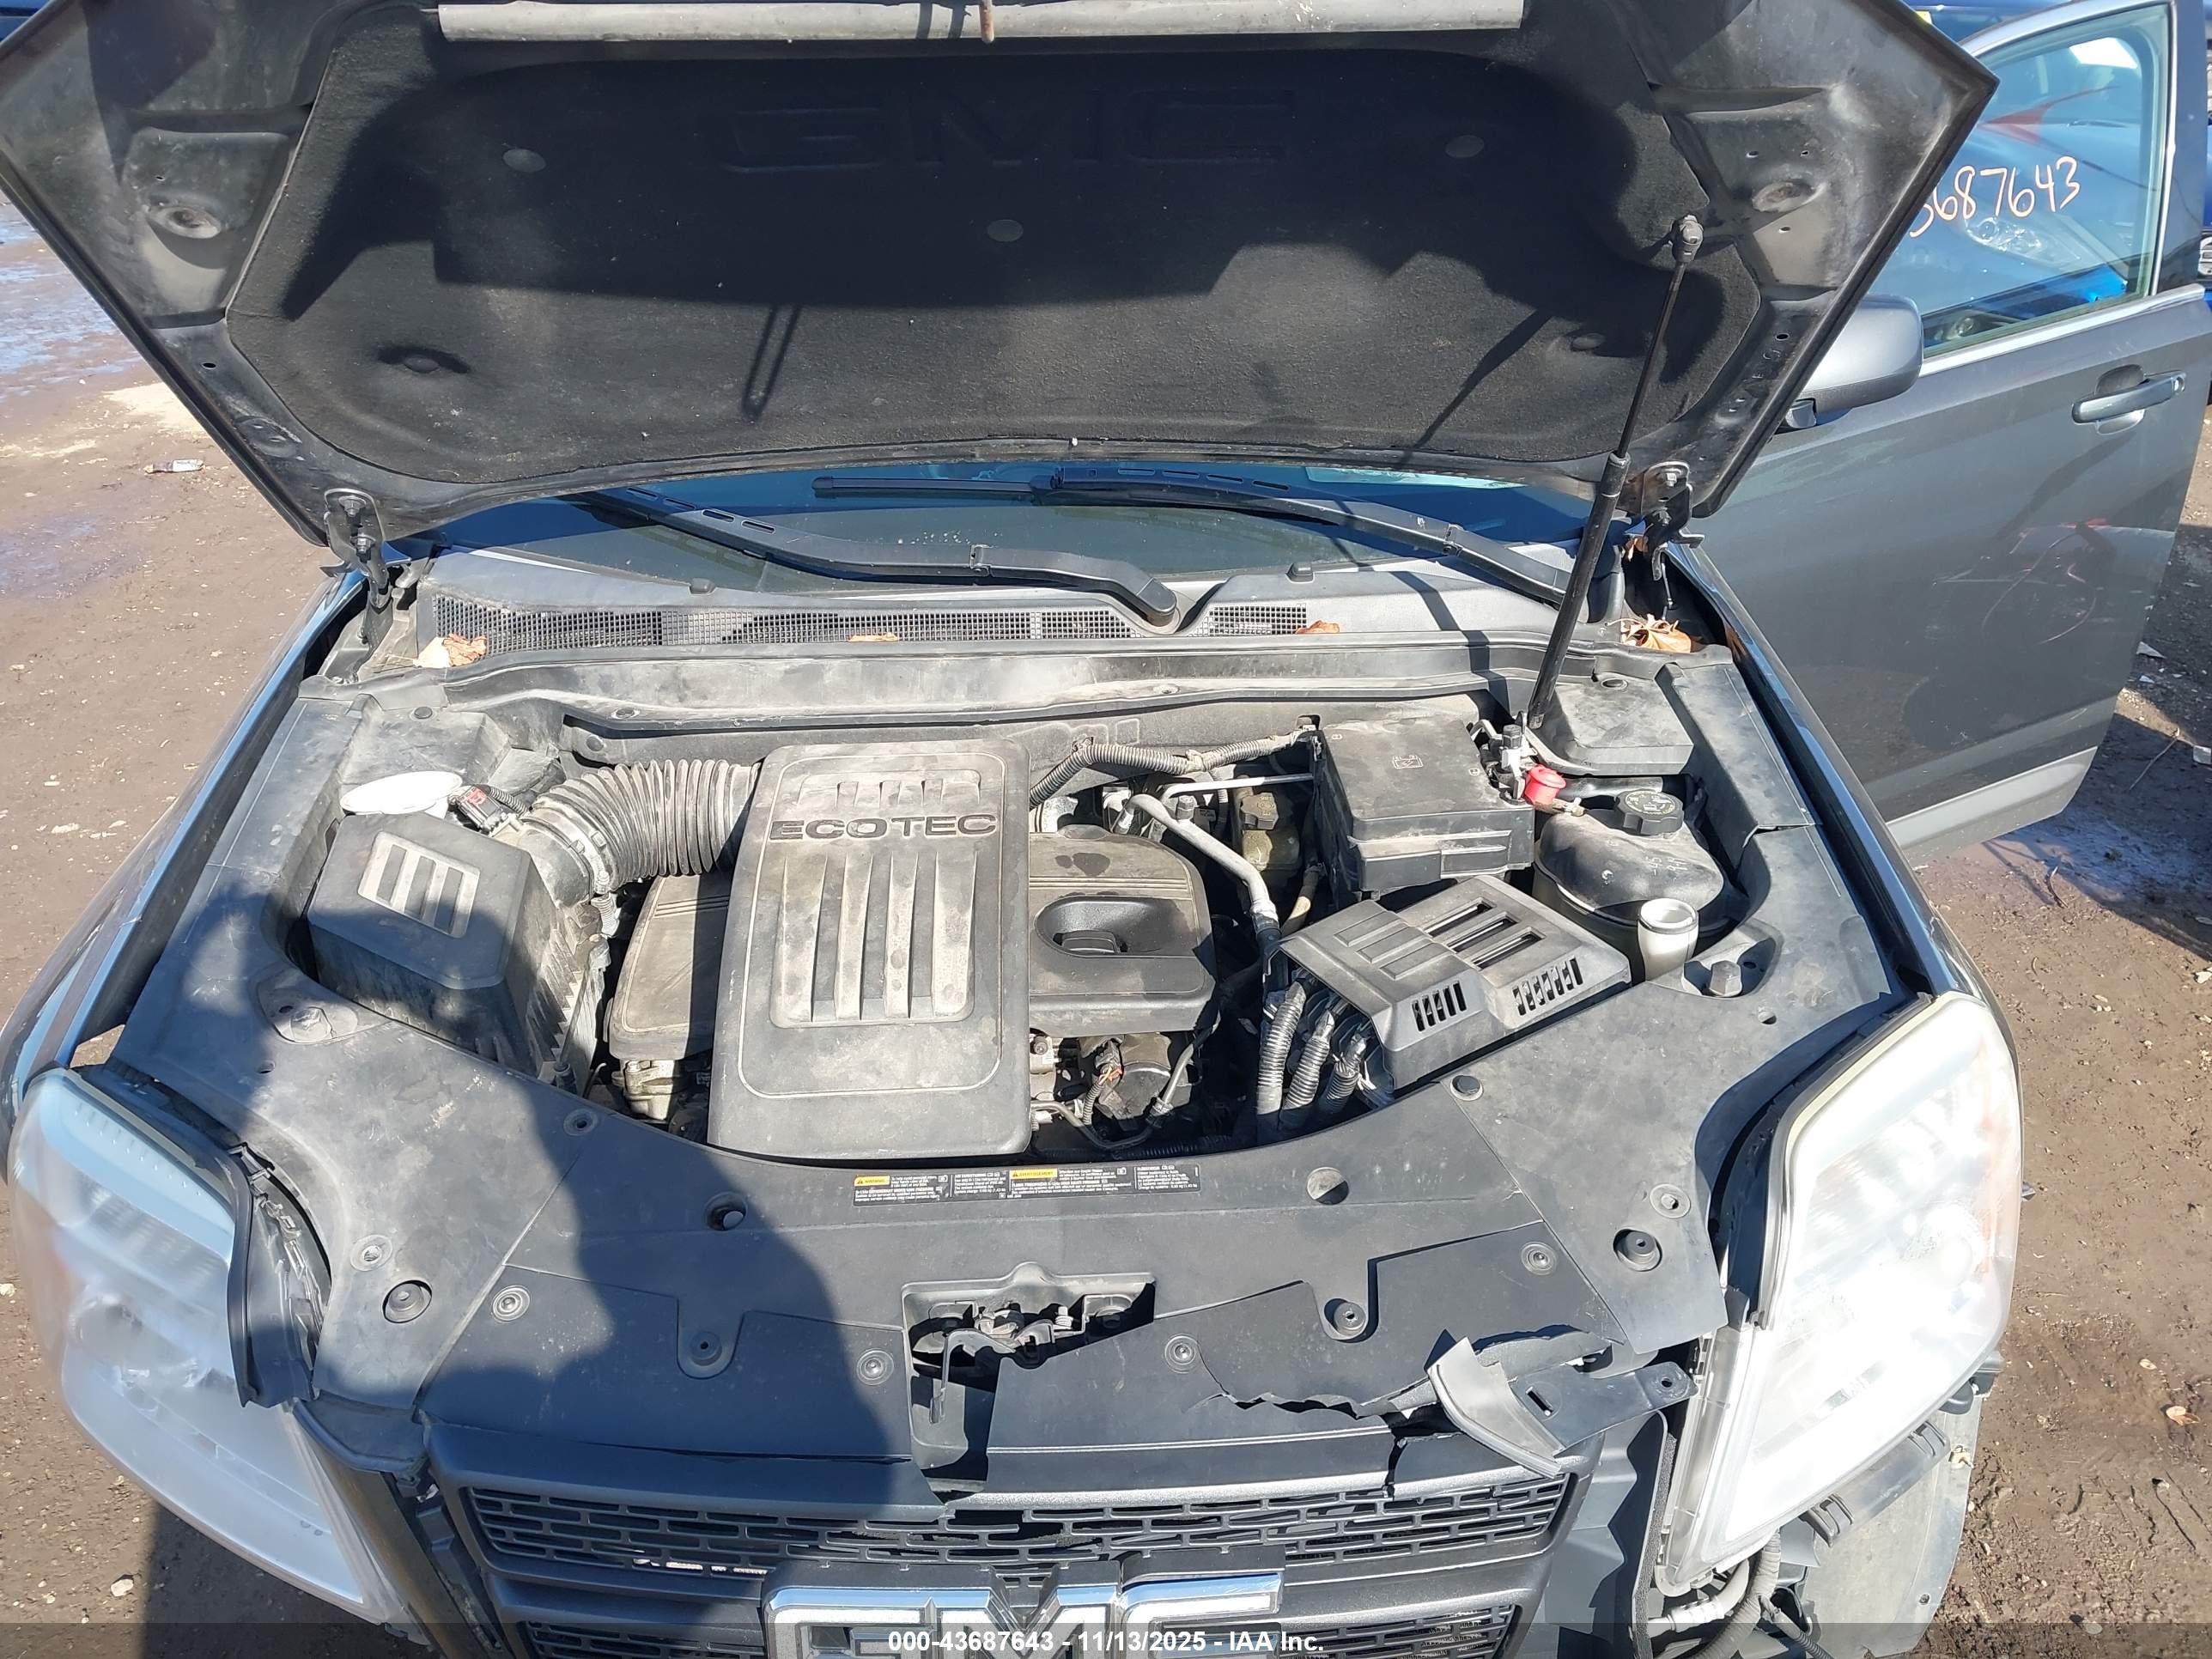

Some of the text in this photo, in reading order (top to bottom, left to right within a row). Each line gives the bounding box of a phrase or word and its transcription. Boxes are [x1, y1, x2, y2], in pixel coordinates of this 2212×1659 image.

[704, 84, 1297, 173] GMC
[769, 814, 997, 840] ECOTEC
[767, 1571, 1285, 1659] GMC
